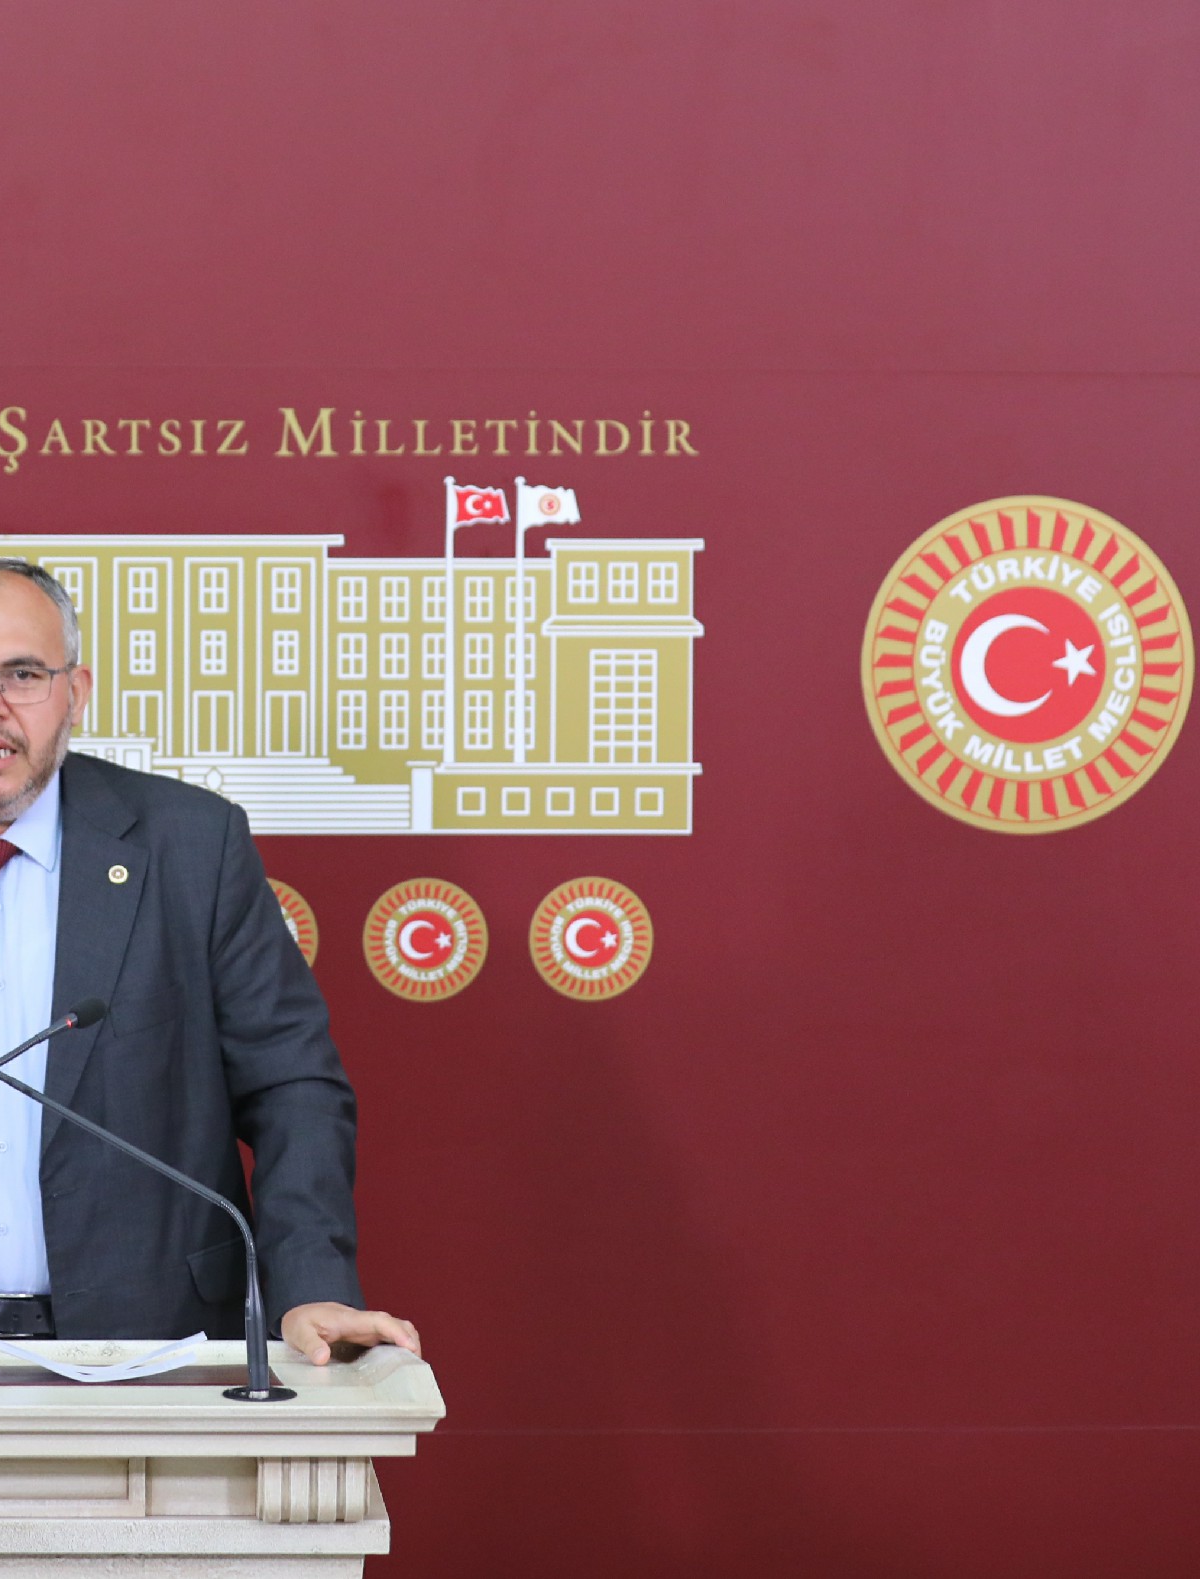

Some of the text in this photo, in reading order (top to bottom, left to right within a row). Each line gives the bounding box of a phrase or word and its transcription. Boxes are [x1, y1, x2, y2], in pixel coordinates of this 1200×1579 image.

[276, 407, 698, 457] MİLLETİNDİR
[948, 554, 1105, 605] TÜRKİYE
[918, 618, 966, 741] BÜYÜK
[962, 733, 1084, 775] MİLLET
